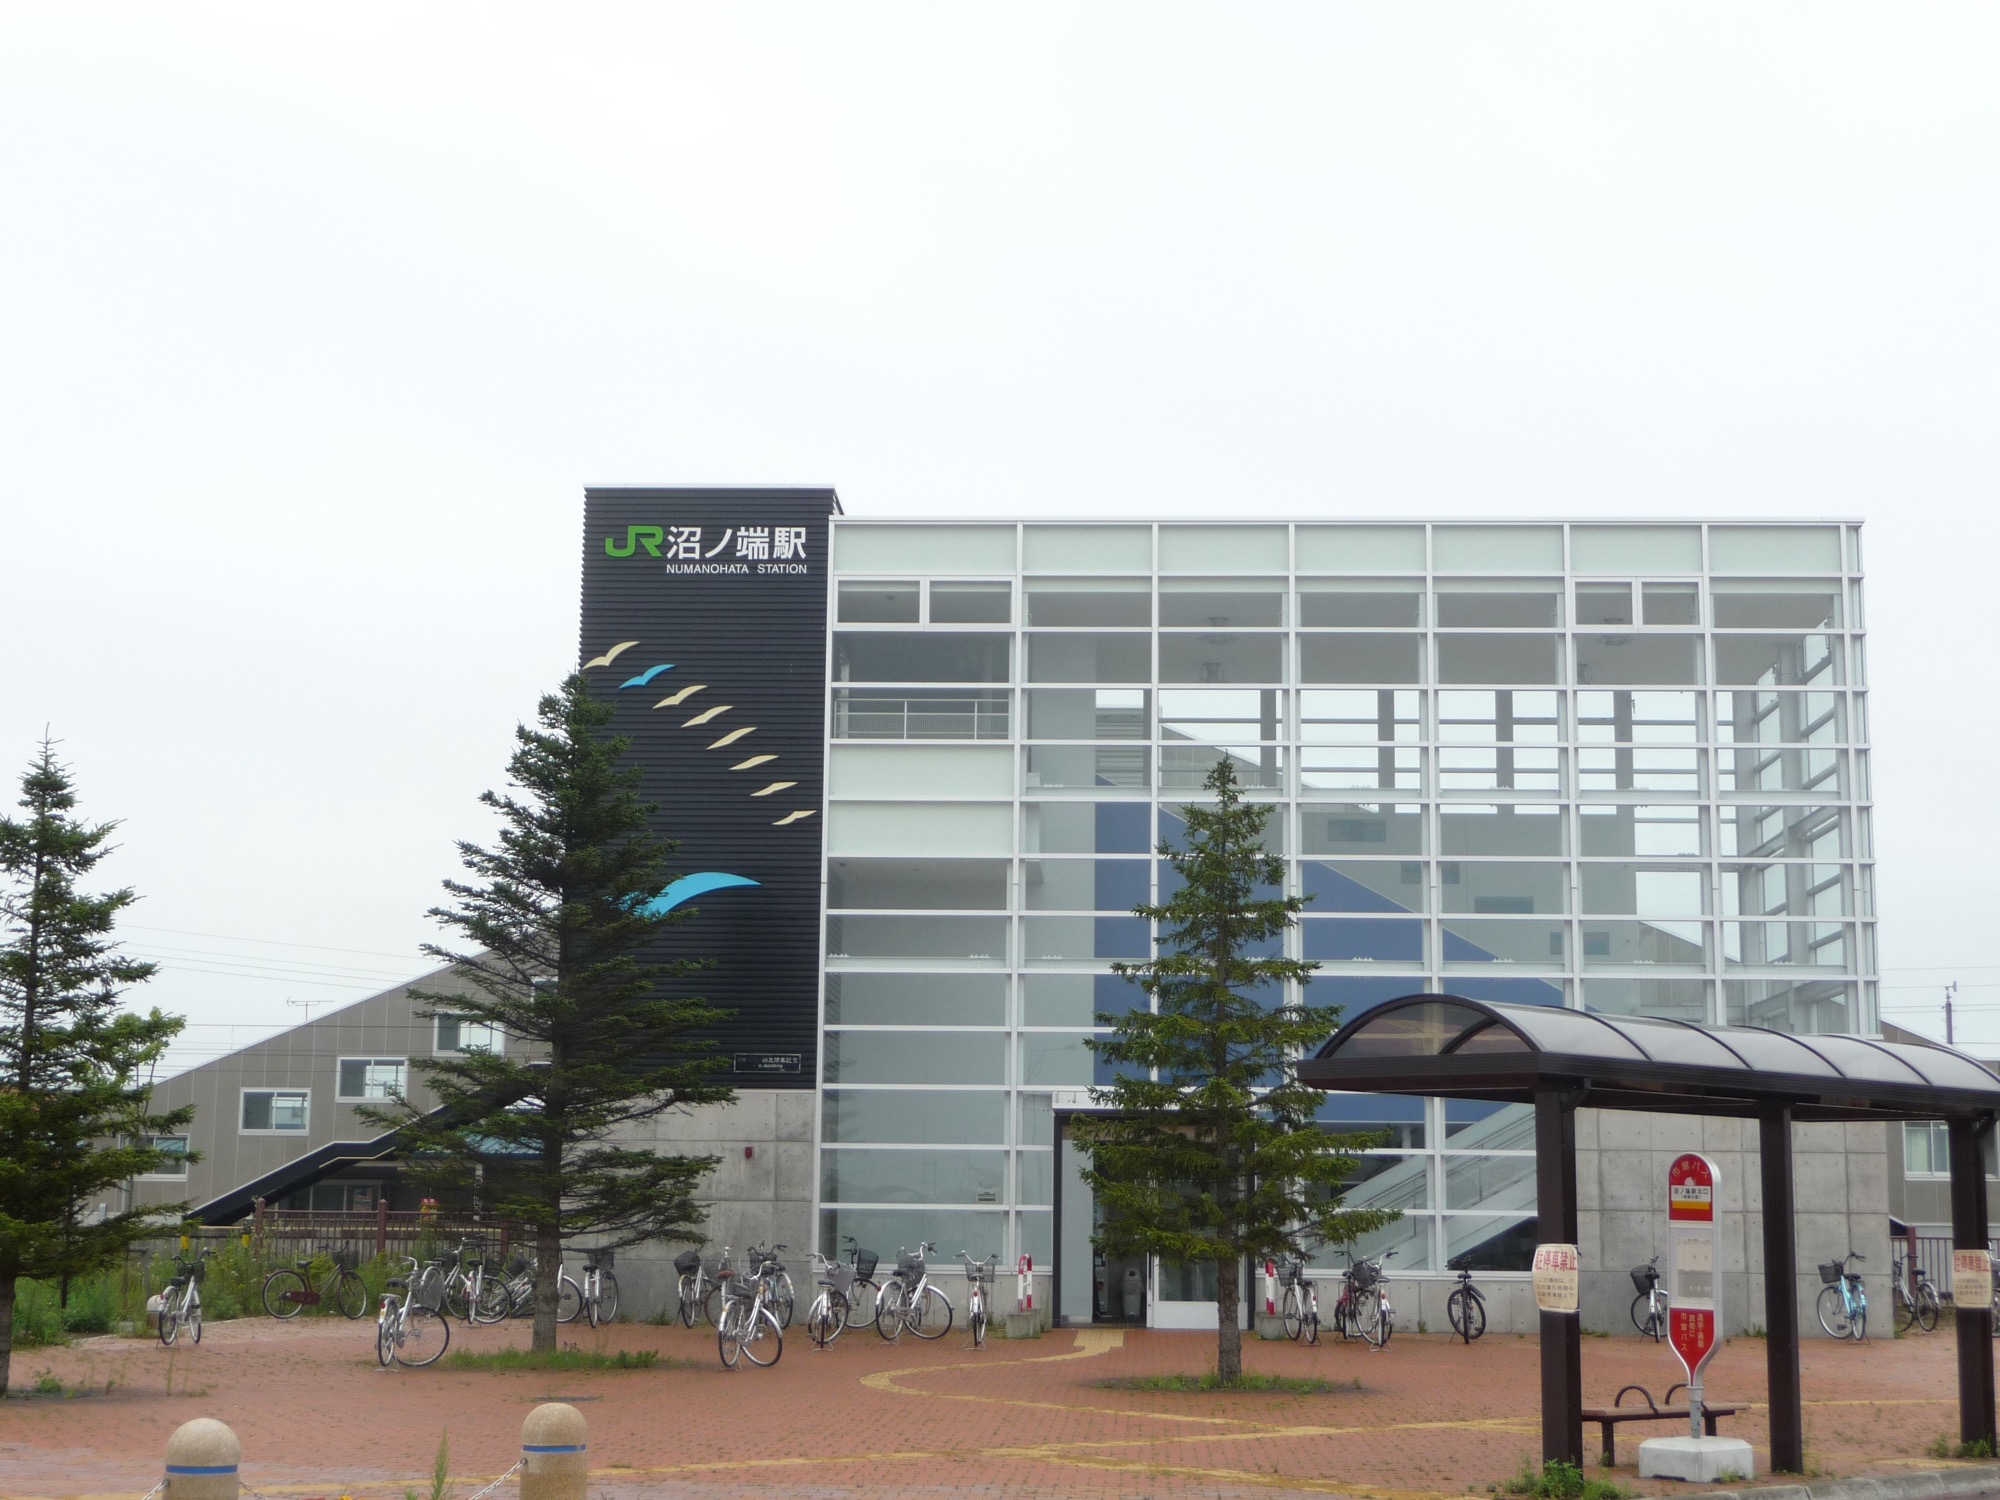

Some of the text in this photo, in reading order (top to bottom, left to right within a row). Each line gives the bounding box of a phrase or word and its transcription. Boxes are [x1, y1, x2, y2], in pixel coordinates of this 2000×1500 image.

[605, 525, 663, 558] JR
[666, 526, 807, 560] 沼ノ端駅
[666, 563, 807, 574] NUMANOHATA STATION
[1535, 1248, 1577, 1272] 駐停車禁止
